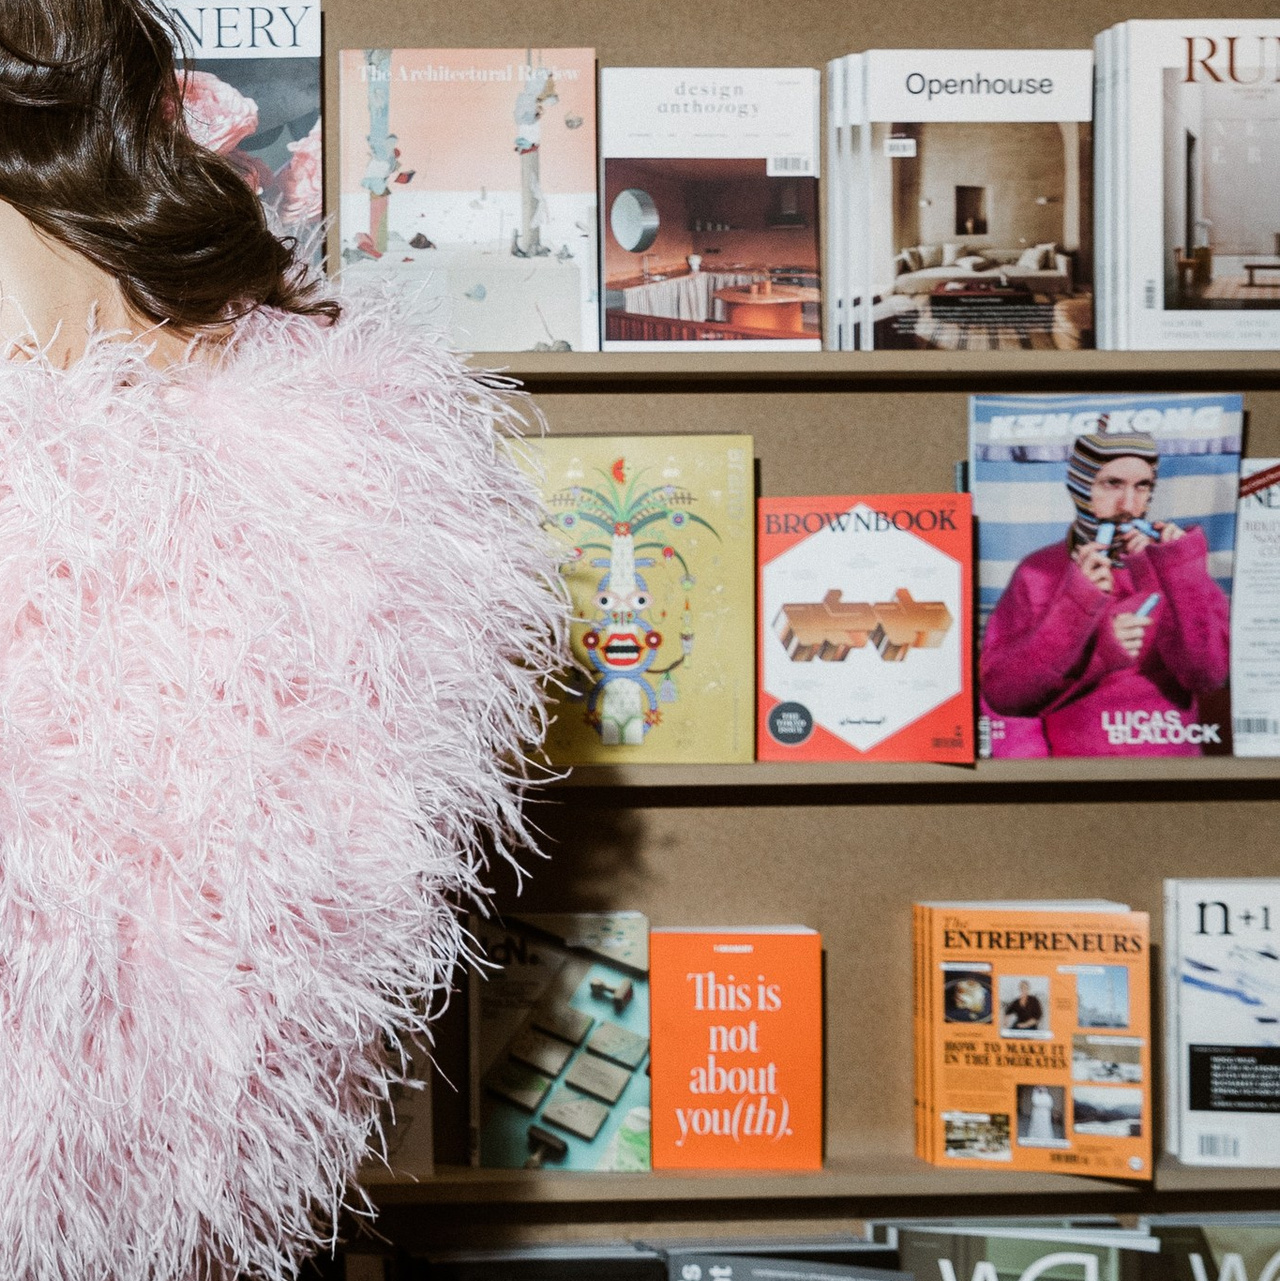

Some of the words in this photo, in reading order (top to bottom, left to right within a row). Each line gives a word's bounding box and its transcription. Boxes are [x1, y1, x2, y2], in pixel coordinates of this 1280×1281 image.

[399, 64, 513, 82] Architectural
[1183, 36, 1280, 84] RU
[674, 81, 745, 99] design
[905, 72, 1054, 102] Openhouse
[656, 100, 759, 118] anthology
[765, 509, 957, 535] BROWNBOOK
[1101, 710, 1182, 731] LUCAS
[1107, 723, 1222, 745] BLALOCK
[943, 929, 1143, 955] ENTREPRENEURS
[686, 970, 753, 1012] This
[757, 974, 782, 1012] is
[708, 1020, 760, 1053] not
[983, 1042, 1002, 1053] TO
[688, 1053, 779, 1095] about
[674, 1093, 794, 1147] you(th).
